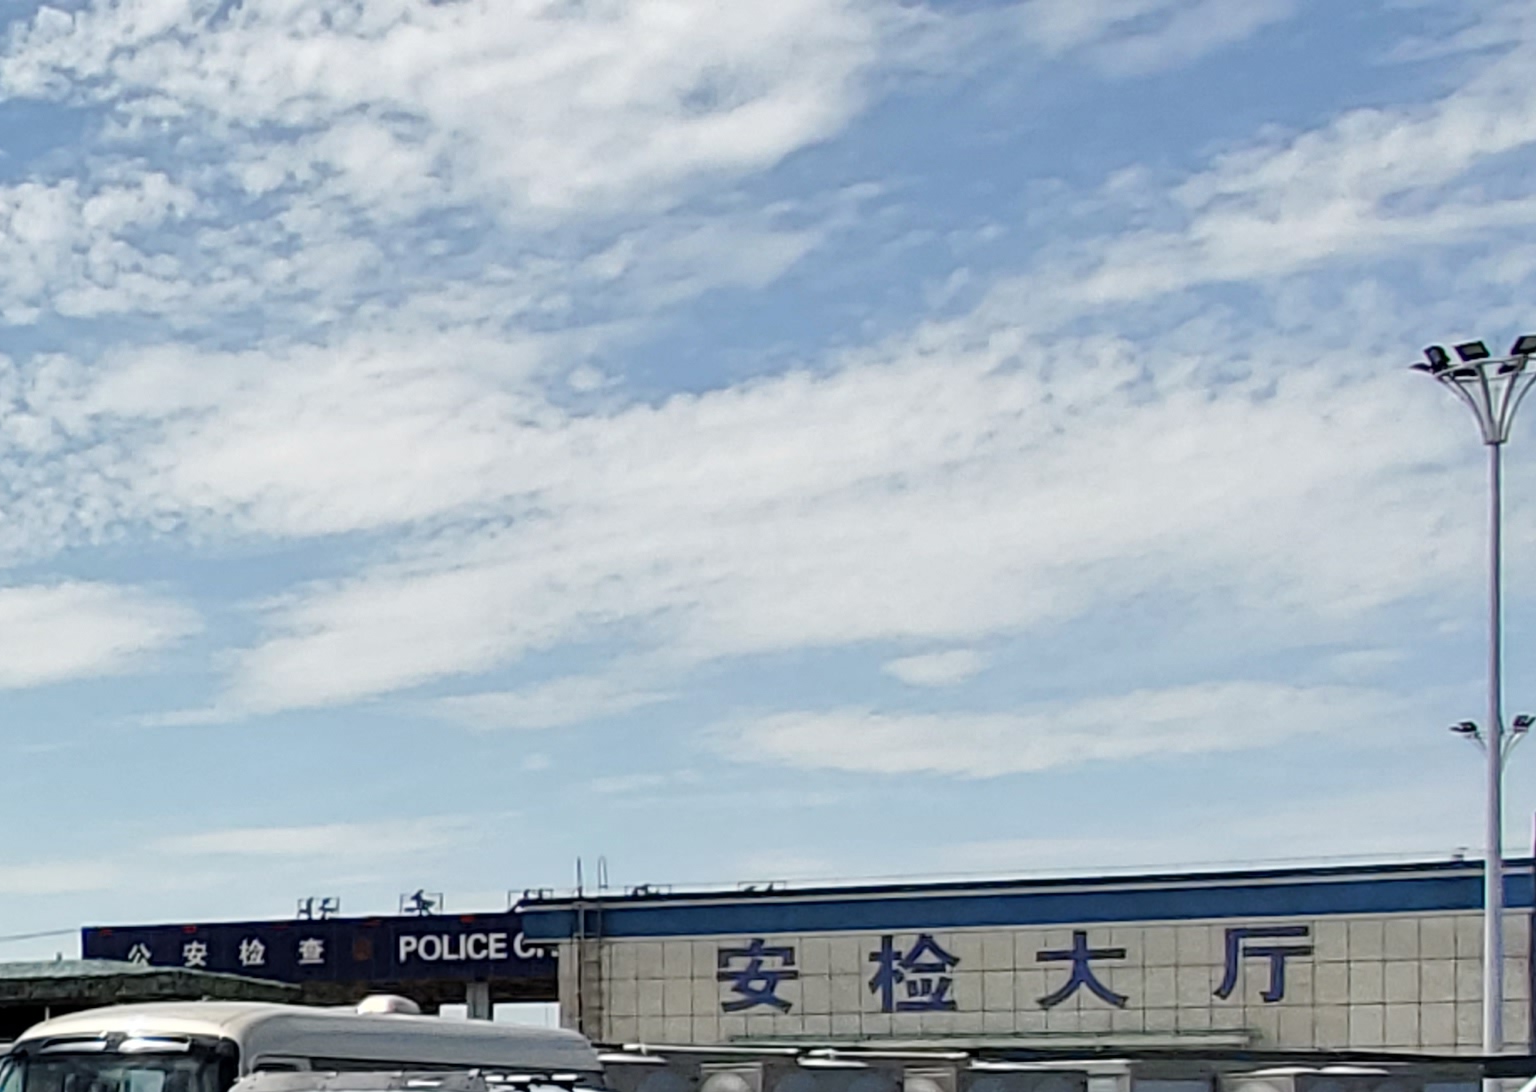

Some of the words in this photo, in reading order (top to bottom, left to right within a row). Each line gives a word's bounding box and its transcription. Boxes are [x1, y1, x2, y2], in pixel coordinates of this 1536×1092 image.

[127, 938, 325, 967] 公安检查
[399, 932, 508, 962] POLICE
[716, 925, 1314, 1014] 安检大厅
